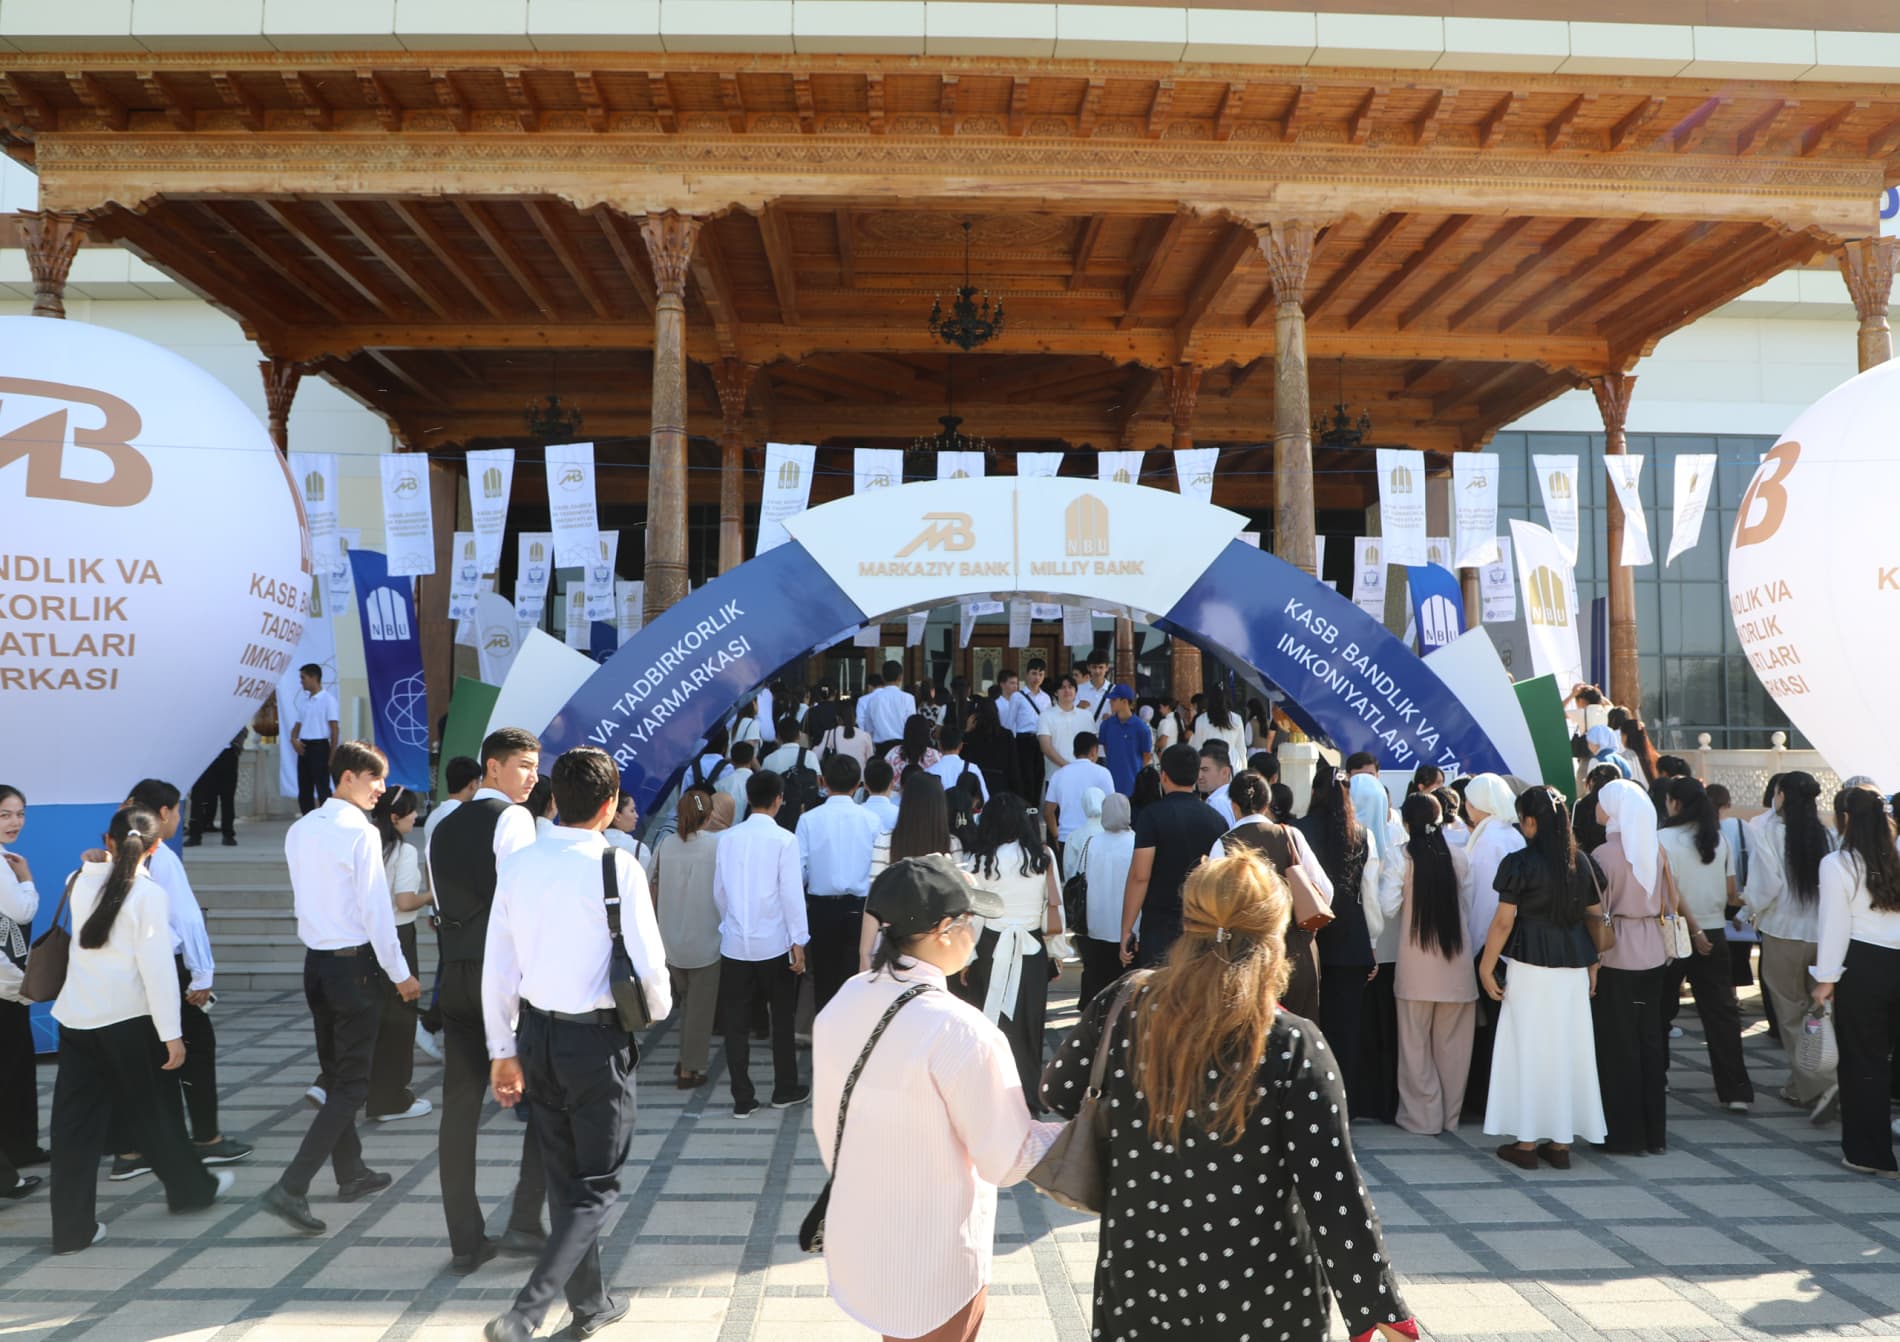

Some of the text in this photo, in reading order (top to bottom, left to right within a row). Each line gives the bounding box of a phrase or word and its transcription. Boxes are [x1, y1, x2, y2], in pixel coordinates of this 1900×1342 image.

[116, 559, 163, 585] VA
[858, 561, 1011, 577] MARKAZIY BANK
[1030, 559, 1145, 576] MILLIY BANK
[1764, 579, 1793, 603] VA
[1532, 606, 1565, 622] NBU
[372, 623, 407, 636] NBU
[0, 667, 119, 691] RKASI
[588, 598, 745, 745] VA TADBIRKORLIK
[630, 635, 752, 743] YARMARKASI
[1276, 633, 1413, 763] IMKONIYATLARI
[1342, 643, 1421, 723] BANDLIK
[1415, 717, 1440, 751] VA
[1437, 746, 1466, 779] TA
